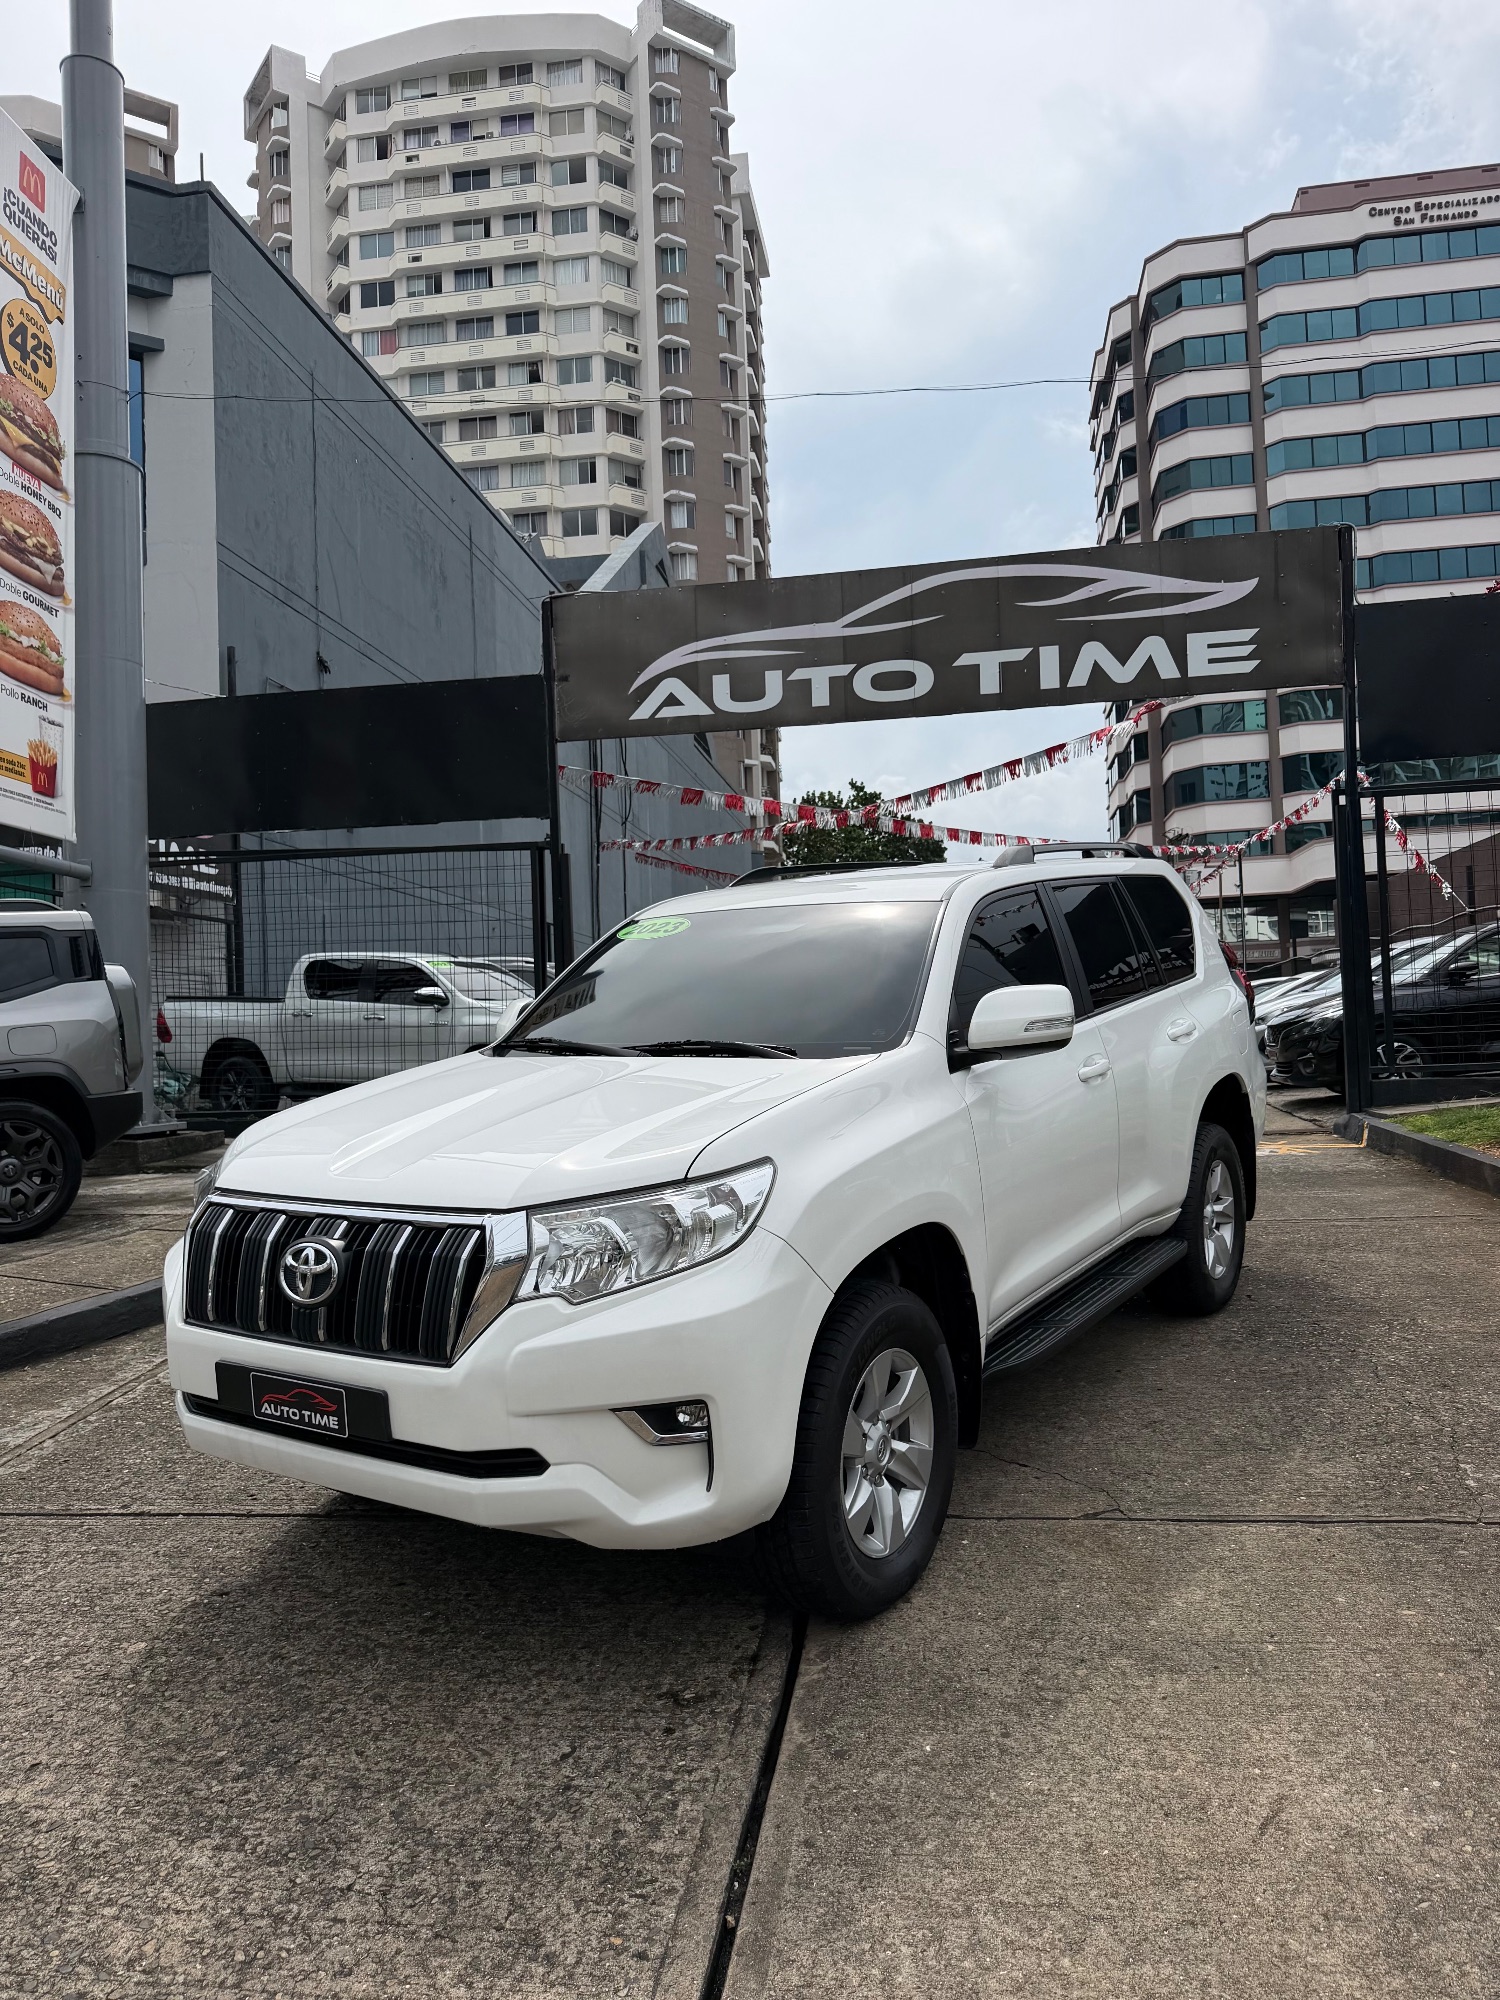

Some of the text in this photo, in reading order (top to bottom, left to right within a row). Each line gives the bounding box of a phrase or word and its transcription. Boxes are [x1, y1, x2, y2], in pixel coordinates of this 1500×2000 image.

[1368, 194, 1500, 217] CENTRO ESPECIALIZADO
[1393, 209, 1479, 226] SAN FERNANDO
[2, 202, 58, 266] QUIERAS!
[25, 311, 45, 334] SOLO
[12, 360, 49, 395] CADA UNA
[13, 464, 41, 491] NUEVA
[20, 481, 48, 505] HONEY
[47, 500, 62, 520] BBQ
[0, 577, 60, 618] Doble GOURMET
[627, 626, 1263, 721] AUTO TIME
[0, 683, 48, 712] Pollo RANCH
[260, 1402, 340, 1430] AUTO TIME
